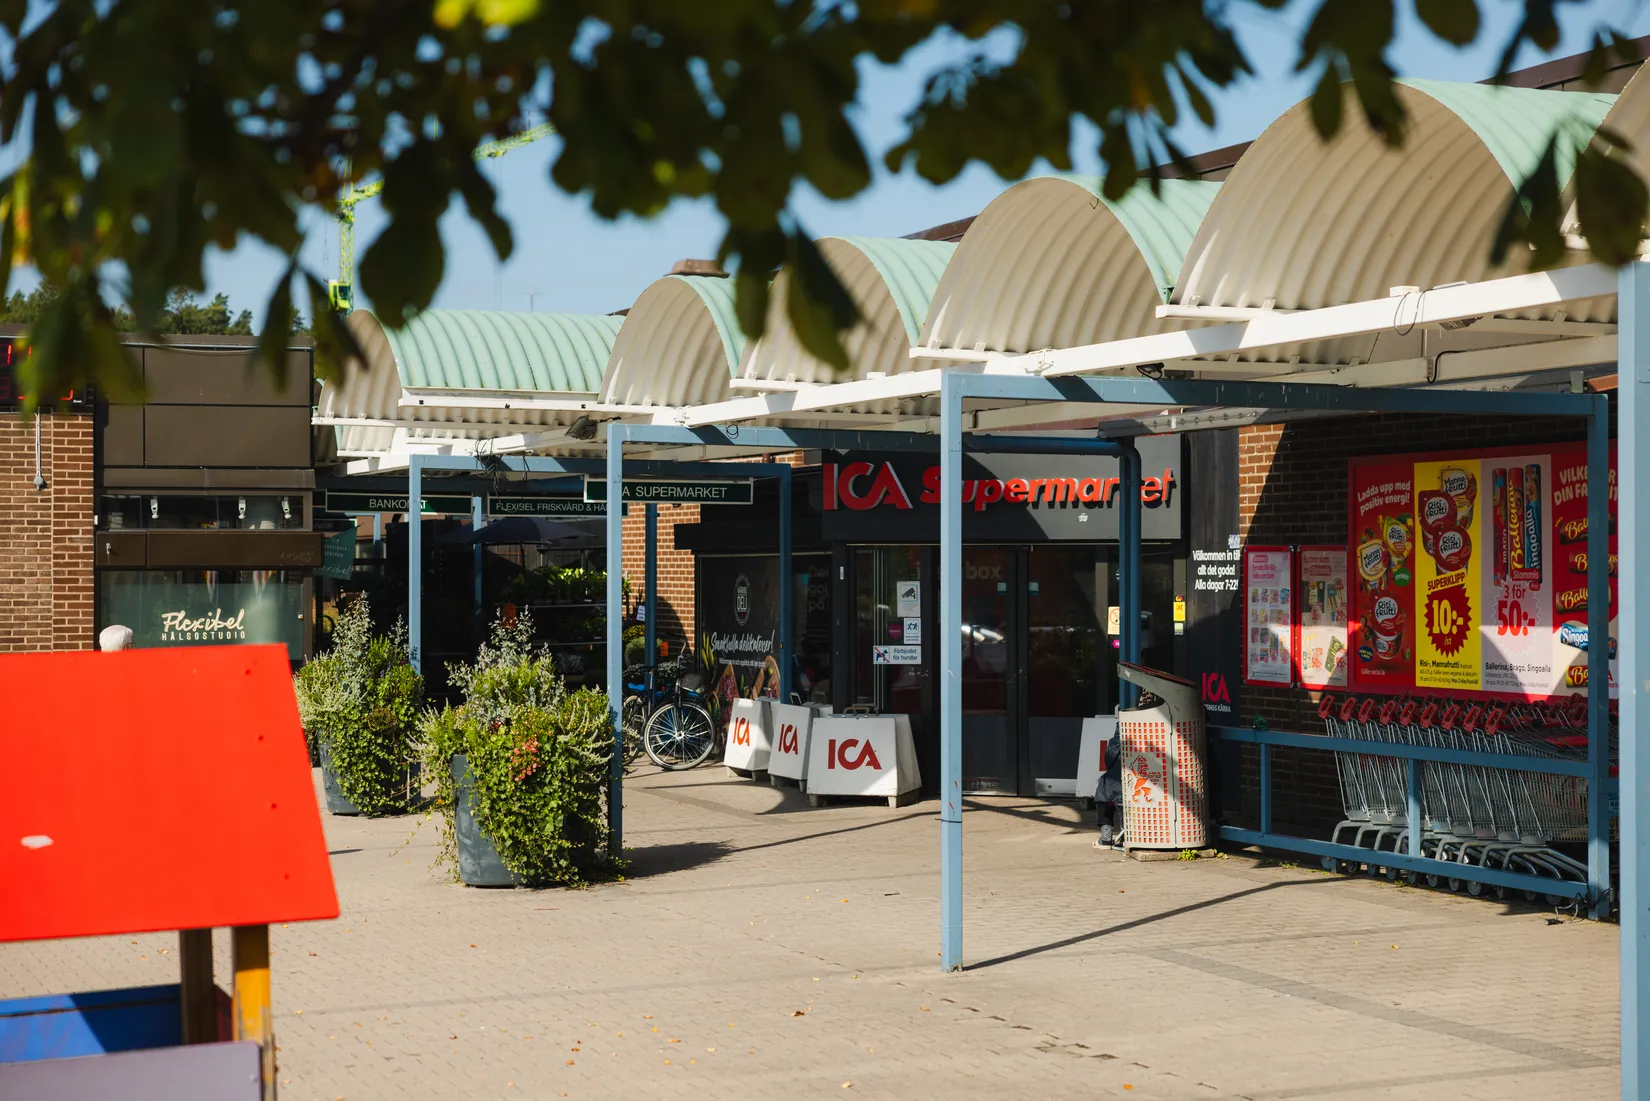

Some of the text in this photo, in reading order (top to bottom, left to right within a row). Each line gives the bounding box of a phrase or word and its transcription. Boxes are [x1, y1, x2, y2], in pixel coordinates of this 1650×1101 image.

[635, 485, 728, 499] SUPERMARKET
[823, 460, 1175, 512] ICA Supermaret
[1357, 480, 1411, 502] Ladda upp med
[1554, 485, 1573, 506] DIN
[369, 498, 428, 510] BANKOT
[496, 502, 536, 512] FLEXIBEL
[537, 501, 584, 512] FRISKVÅRD
[585, 503, 592, 512] &
[1360, 493, 1410, 516] positiv energi!
[1192, 549, 1226, 561] Välkommen
[1226, 549, 1233, 561] in
[1197, 564, 1236, 578] allt det goda!
[1513, 570, 1540, 580] Stammis
[1194, 579, 1206, 590] Alla
[1206, 579, 1225, 593] dagar
[1427, 572, 1466, 591] SUPERKLIPP
[1503, 584, 1527, 599] 3 för
[161, 608, 245, 633] Flexibel
[1432, 599, 1464, 635] 10:-
[1497, 599, 1536, 636] 50:-
[1432, 660, 1460, 669] Mannafrutti
[1485, 662, 1551, 674] Ballerina, Brago, Singoalla
[1201, 671, 1231, 705] ICA
[1217, 703, 1232, 713] KÄRRA
[733, 716, 751, 747] ICA
[778, 723, 800, 756] ICA
[827, 738, 882, 771] ICA
